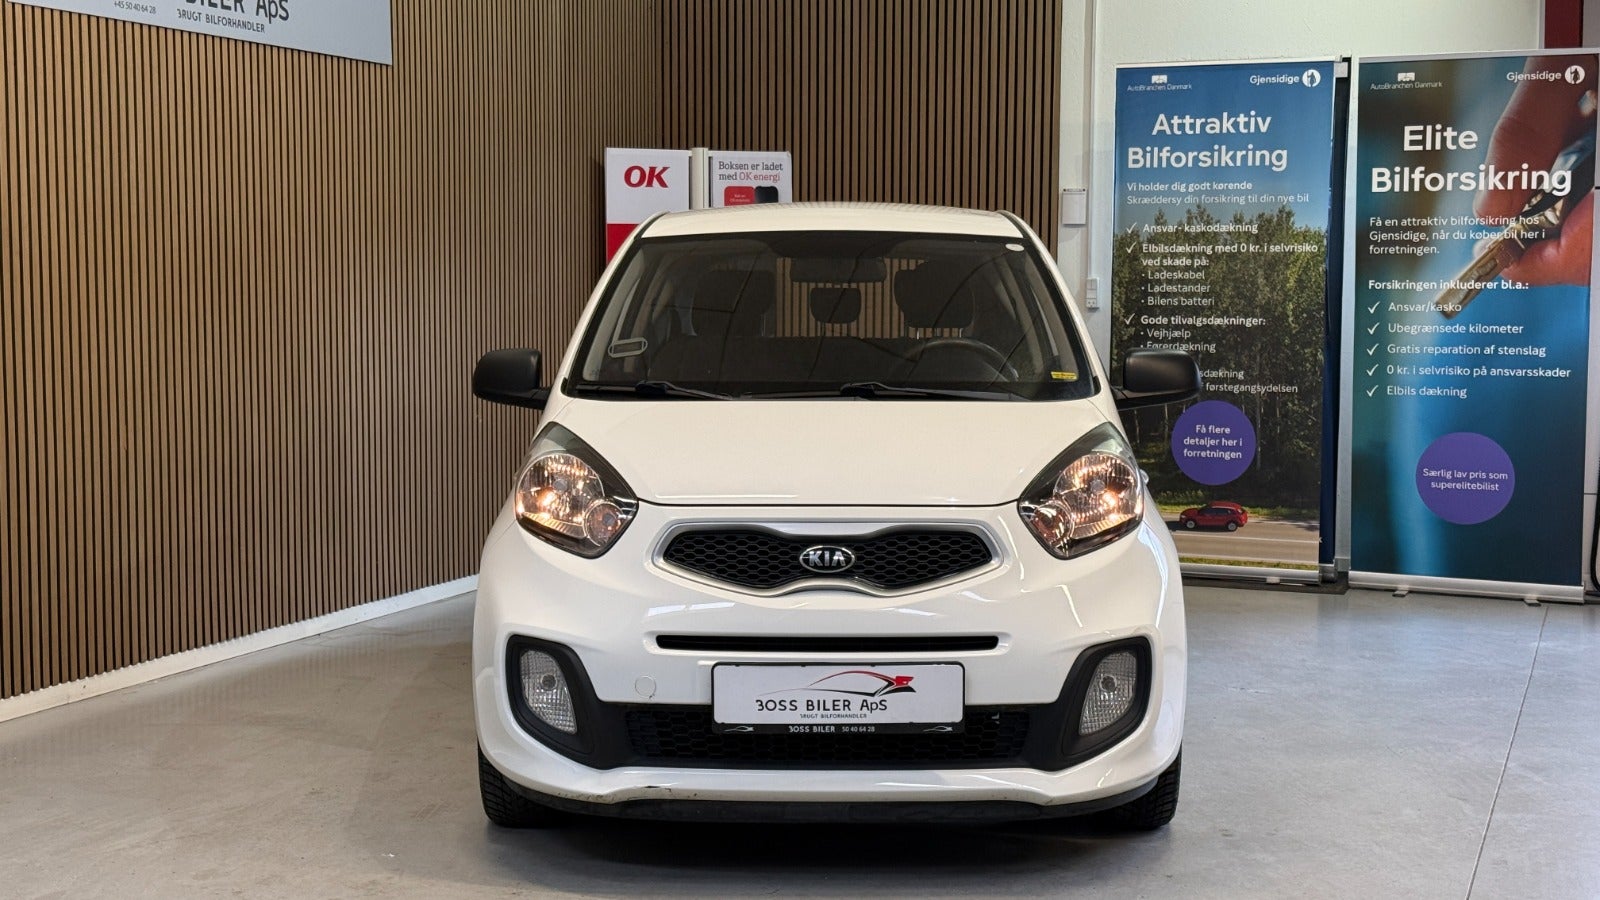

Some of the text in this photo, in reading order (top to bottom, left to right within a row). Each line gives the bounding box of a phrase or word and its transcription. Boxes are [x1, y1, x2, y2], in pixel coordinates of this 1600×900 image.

[256, 0, 290, 24] ApS
[205, 13, 265, 33] BILFORHANDLER
[1250, 75, 1300, 85] Gjensidige
[1506, 70, 1561, 82] Gjensidige
[1370, 81, 1442, 90] AutoBranchen Danmark
[1151, 110, 1272, 135] Attraktiv
[1403, 123, 1478, 151] Elite
[1127, 144, 1288, 172] Bilforsikring
[719, 161, 783, 171] Boksen er ladet
[624, 165, 670, 188] OK
[719, 172, 781, 183] med OK energi
[1371, 163, 1572, 197] Bilforsikring
[1127, 181, 1253, 193] Vi holder dig godt kørende
[1127, 193, 1309, 205] Skræddersy din forsikring til din nye bil
[1370, 215, 1540, 227] Få en attraktiv bilforsikring hos
[1143, 223, 1259, 235] Ansvar- kaskodækning
[1369, 230, 1429, 242] Gjensidige,
[1432, 228, 1450, 240] når
[1452, 229, 1467, 240] du
[1469, 229, 1502, 240] køber
[1503, 229, 1518, 239] bil
[1520, 229, 1539, 239] her
[1142, 244, 1213, 255] Elbilsdækning
[1214, 243, 1238, 253] med
[1240, 243, 1247, 252] 0
[1249, 243, 1262, 253] kr.
[1269, 242, 1318, 252] selvrisiko
[1369, 244, 1440, 255] forretningen.
[1142, 256, 1209, 268] ved skade på:
[1148, 270, 1205, 280] Ladeskabel
[1147, 283, 1211, 293] Ladestander
[1368, 279, 1529, 291] Forsikringen inkluderer bl.a.:
[1147, 296, 1215, 306] Bilens batteri
[1388, 301, 1462, 313] Ansvar/kasko
[1140, 314, 1266, 327] Gode tilvalgsdækninger:
[1146, 329, 1191, 340] Vejhjælp
[1388, 323, 1524, 335] Ubegrænsede kilometer
[1387, 343, 1546, 357] Gratis reparation af stenslag
[1199, 369, 1244, 380] sdækning
[1387, 365, 1394, 375] 0
[1397, 365, 1410, 375] kr.
[1418, 365, 1470, 376] selvrisiko
[1473, 365, 1487, 378] på
[1490, 367, 1571, 378] ansvarsskader
[1206, 382, 1298, 394] førstegangsydelsen
[1387, 385, 1467, 398] Elbils dækning
[1196, 424, 1230, 434] Få flere
[1183, 437, 1219, 448] detaljer
[1221, 438, 1237, 447] her
[1183, 448, 1242, 460] forretningen
[1423, 468, 1508, 480] Særlig lav pris som
[1431, 481, 1500, 491] superelitebilist
[809, 550, 846, 567] KIA
[806, 699, 851, 711] BILER
[860, 699, 888, 714] ApS
[812, 725, 835, 733] BILER
